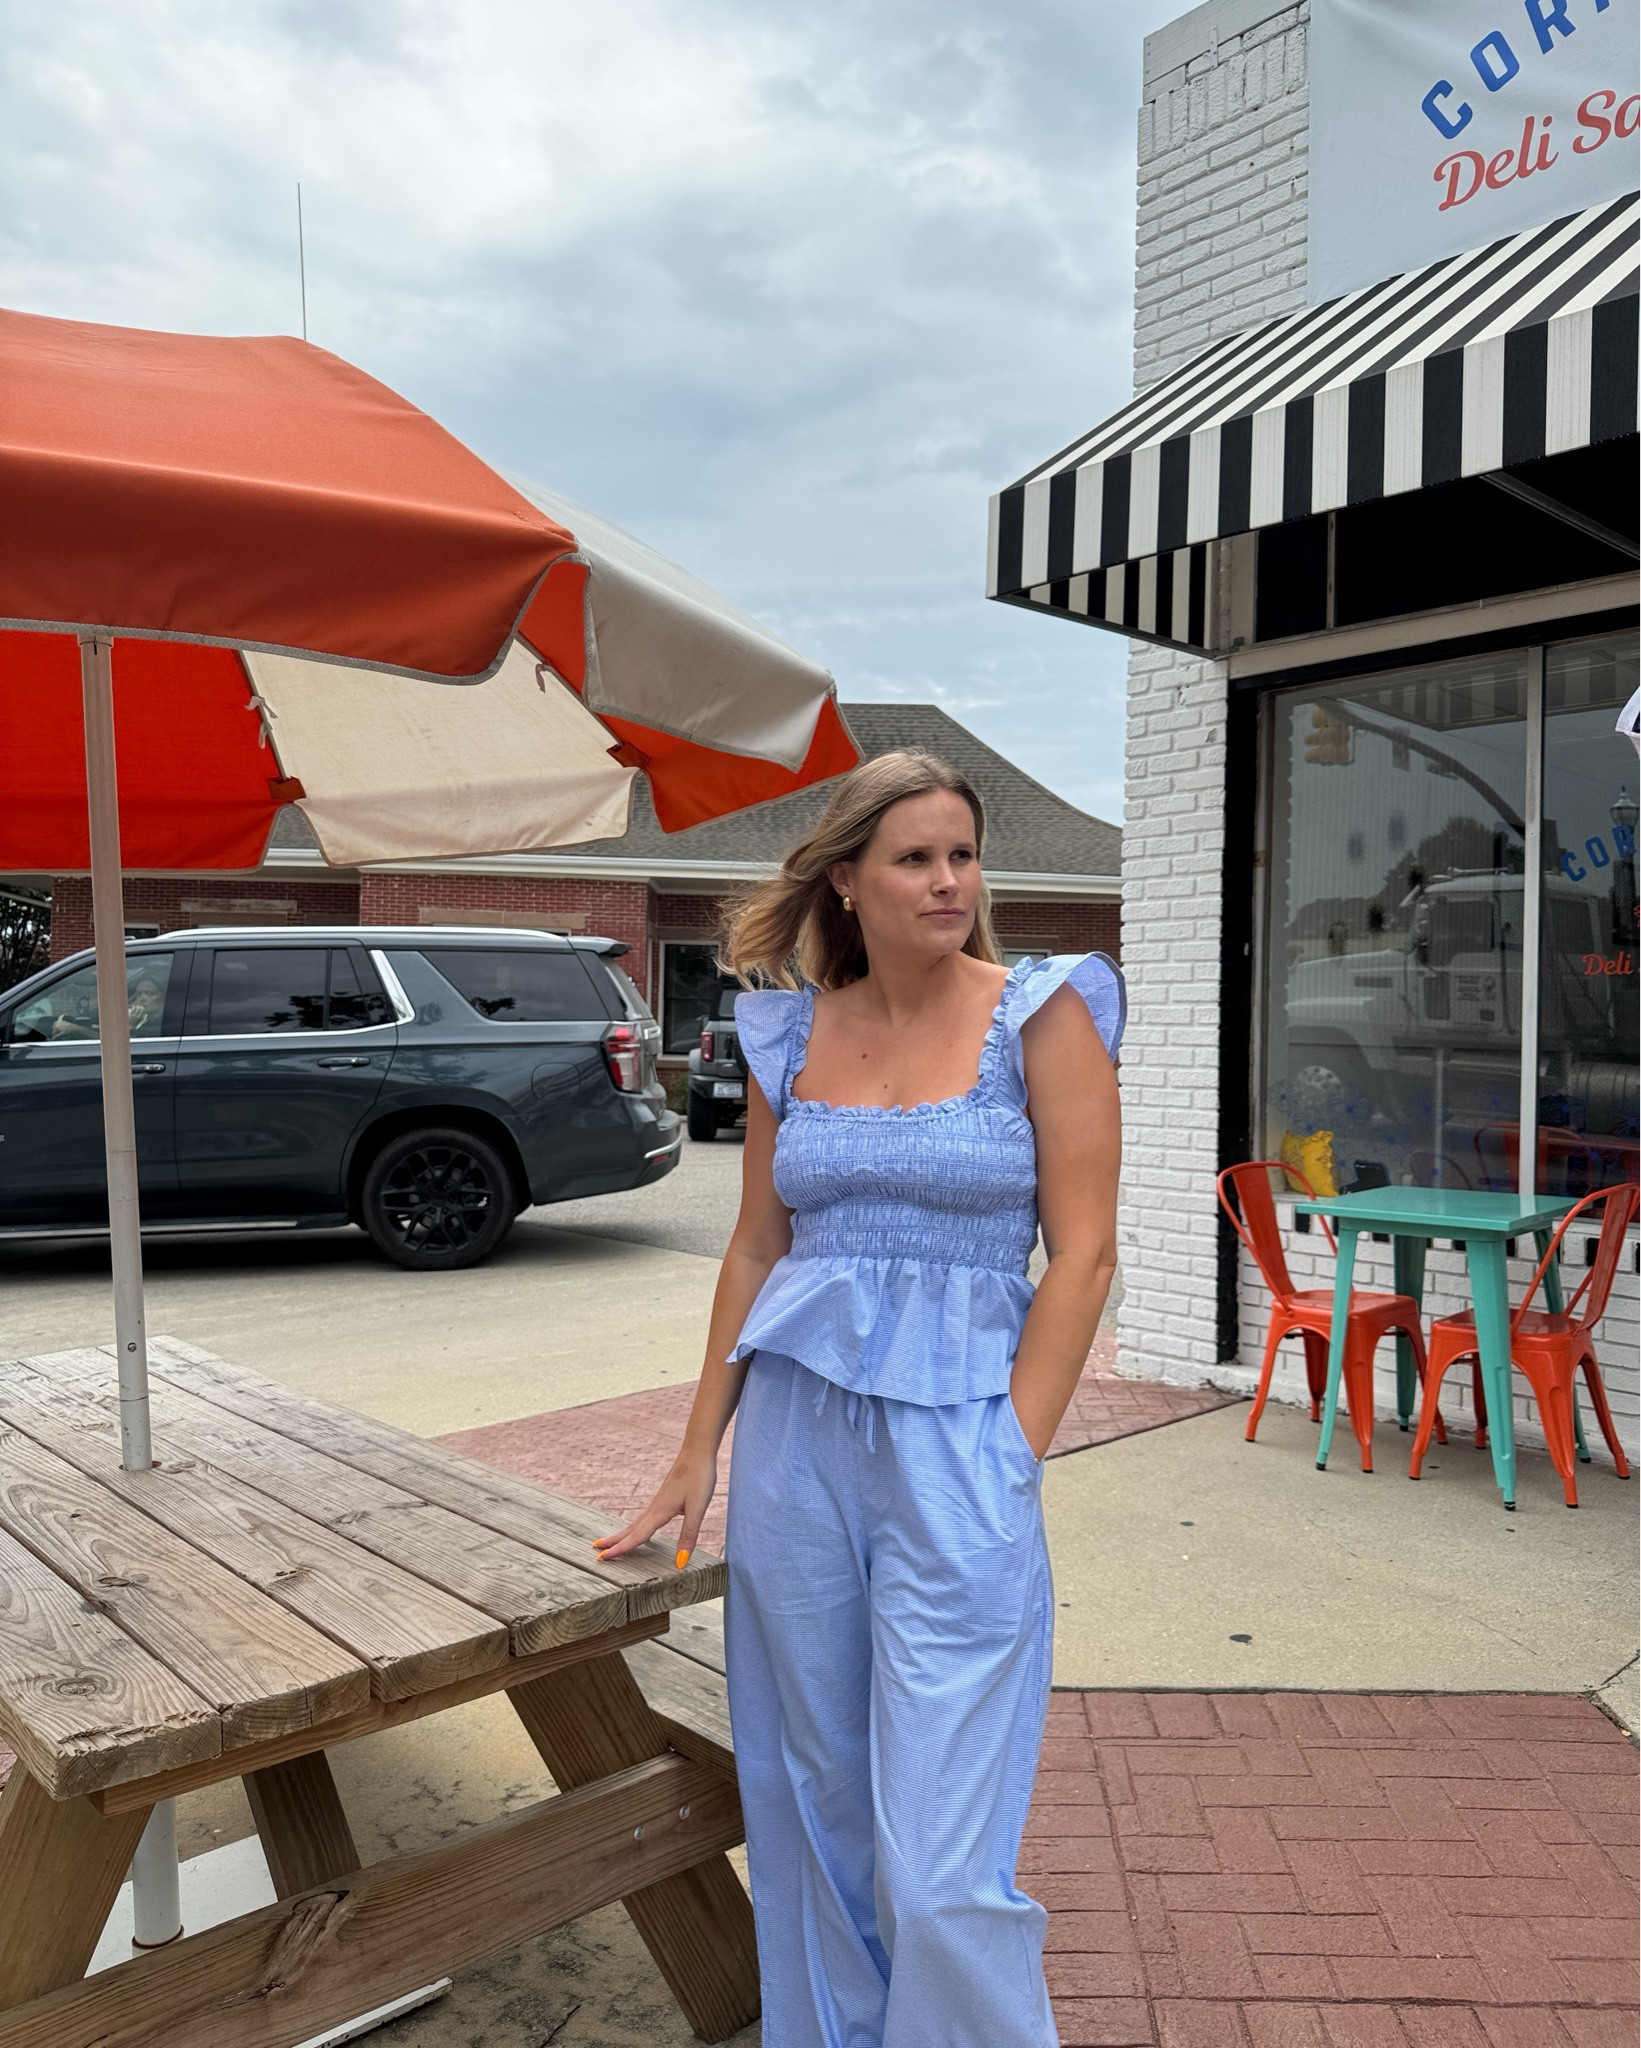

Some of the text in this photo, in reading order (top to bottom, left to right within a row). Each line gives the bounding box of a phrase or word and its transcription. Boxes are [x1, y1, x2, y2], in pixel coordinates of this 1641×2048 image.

[1421, 0, 1610, 140] COR
[1433, 115, 1559, 212] Deli
[1559, 824, 1637, 882] COR
[1581, 951, 1633, 976] Deli
